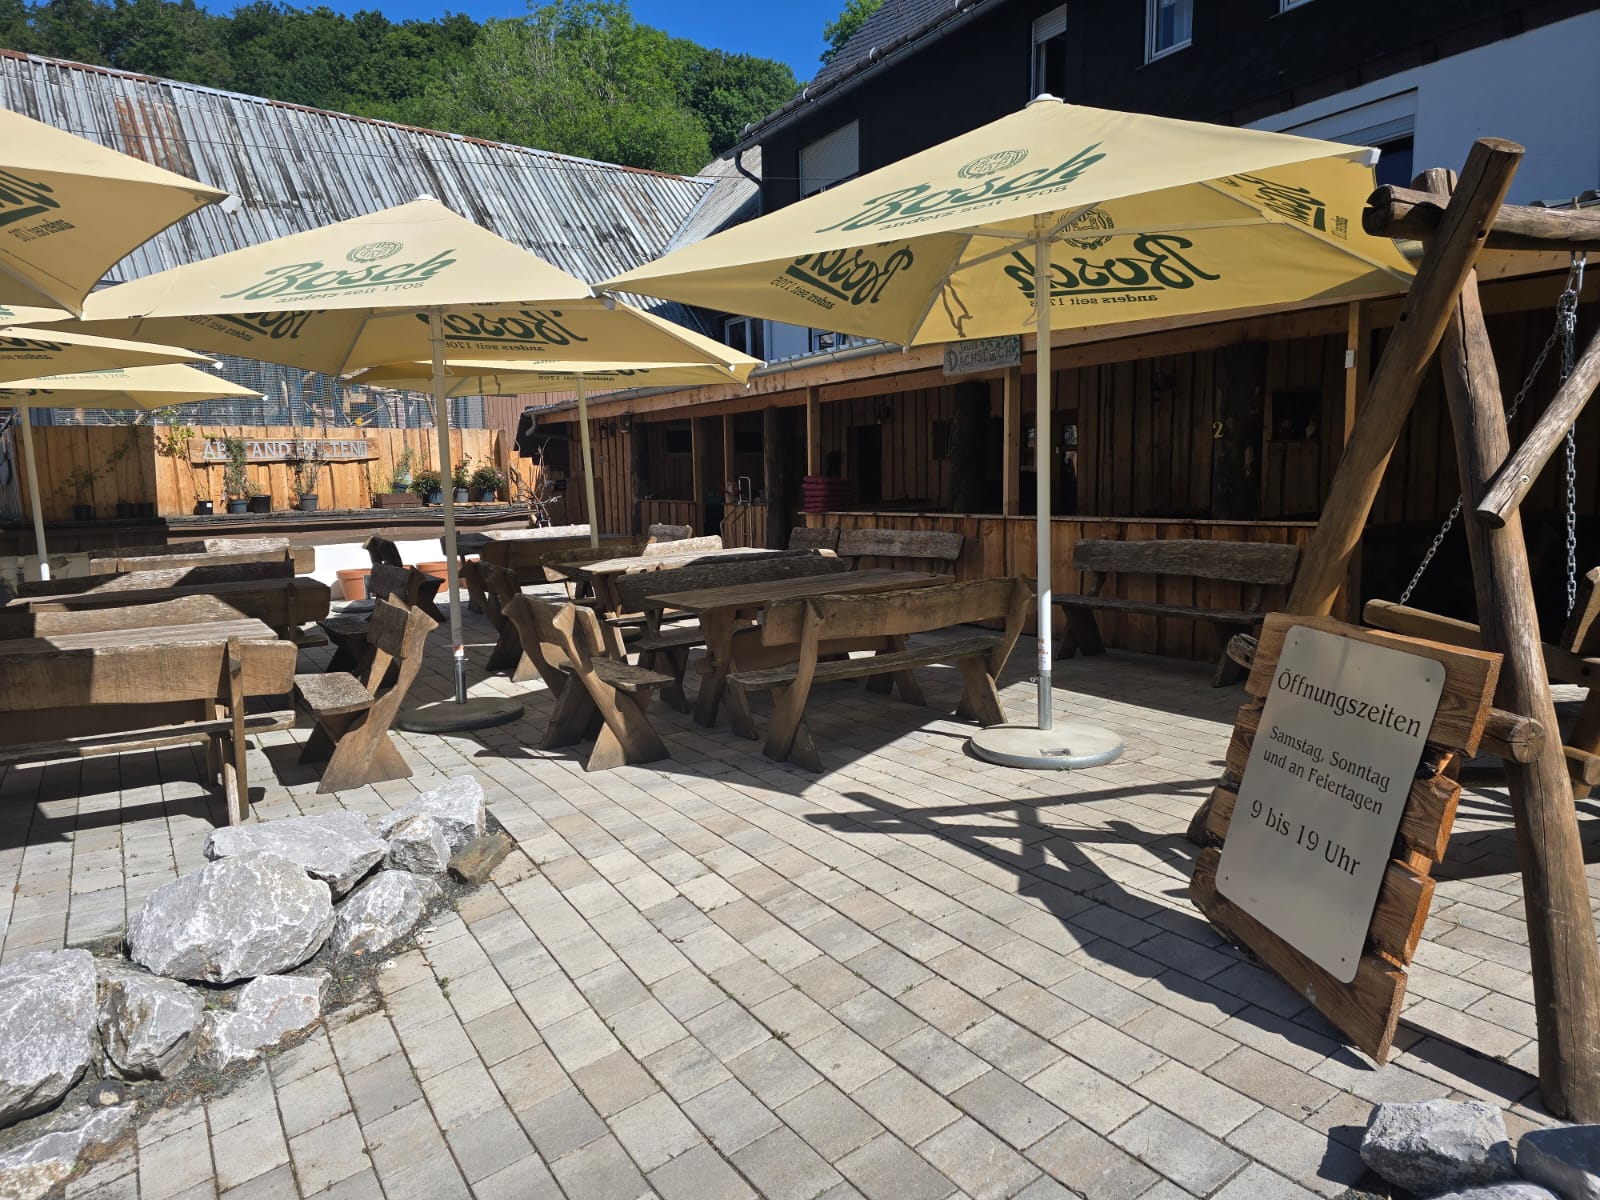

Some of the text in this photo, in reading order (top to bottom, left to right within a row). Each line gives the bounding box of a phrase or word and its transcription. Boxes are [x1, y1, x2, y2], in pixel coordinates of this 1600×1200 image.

[814, 140, 1106, 234] Bosch
[878, 208, 955, 231] anders
[957, 199, 1004, 217] seit
[220, 248, 457, 301] Bosch
[275, 281, 425, 304] anders seit 1705
[945, 345, 1012, 372] DACHSLCH
[203, 440, 290, 460] ABAND
[1212, 421, 1224, 438] 2
[1277, 667, 1421, 738] Öffnungszeiten
[1263, 749, 1383, 815] und an Feiertagen
[1269, 725, 1391, 793] Samstag, Sonntag
[1250, 799, 1361, 876] 9 bis 19 Uhr
